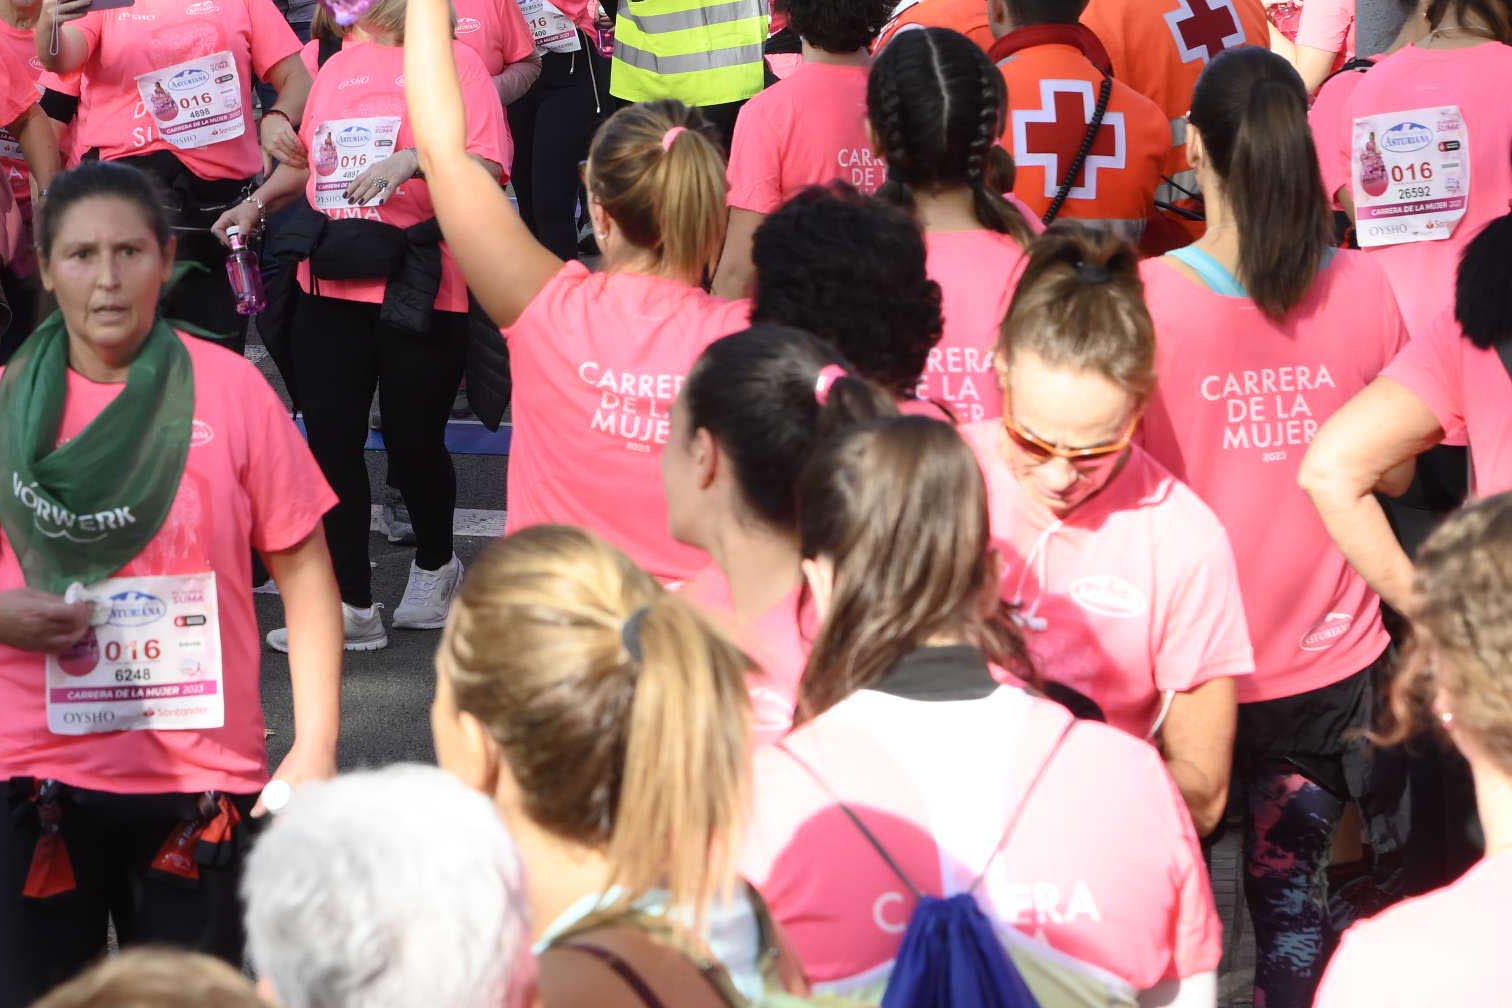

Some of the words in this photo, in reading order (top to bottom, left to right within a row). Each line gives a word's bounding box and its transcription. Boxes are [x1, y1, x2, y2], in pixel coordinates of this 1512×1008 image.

[179, 92, 212, 109] 016
[341, 154, 367, 168] 016
[852, 168, 874, 186] DE
[1391, 162, 1432, 182] 016
[1399, 186, 1431, 199] 26592
[942, 376, 980, 400] LA
[1201, 363, 1336, 401] CARRERA
[601, 395, 636, 416] DE
[1227, 396, 1265, 423] DE
[1276, 393, 1312, 419] LA
[1223, 419, 1318, 449] MUJER
[13, 472, 137, 531] VORWERK
[105, 640, 161, 662] 016
[115, 668, 152, 682] 6248
[67, 689, 114, 700] CARRERA
[116, 689, 129, 698] DE
[131, 688, 144, 697] LA
[145, 686, 179, 697] MUJER
[63, 710, 116, 724] OYSHO
